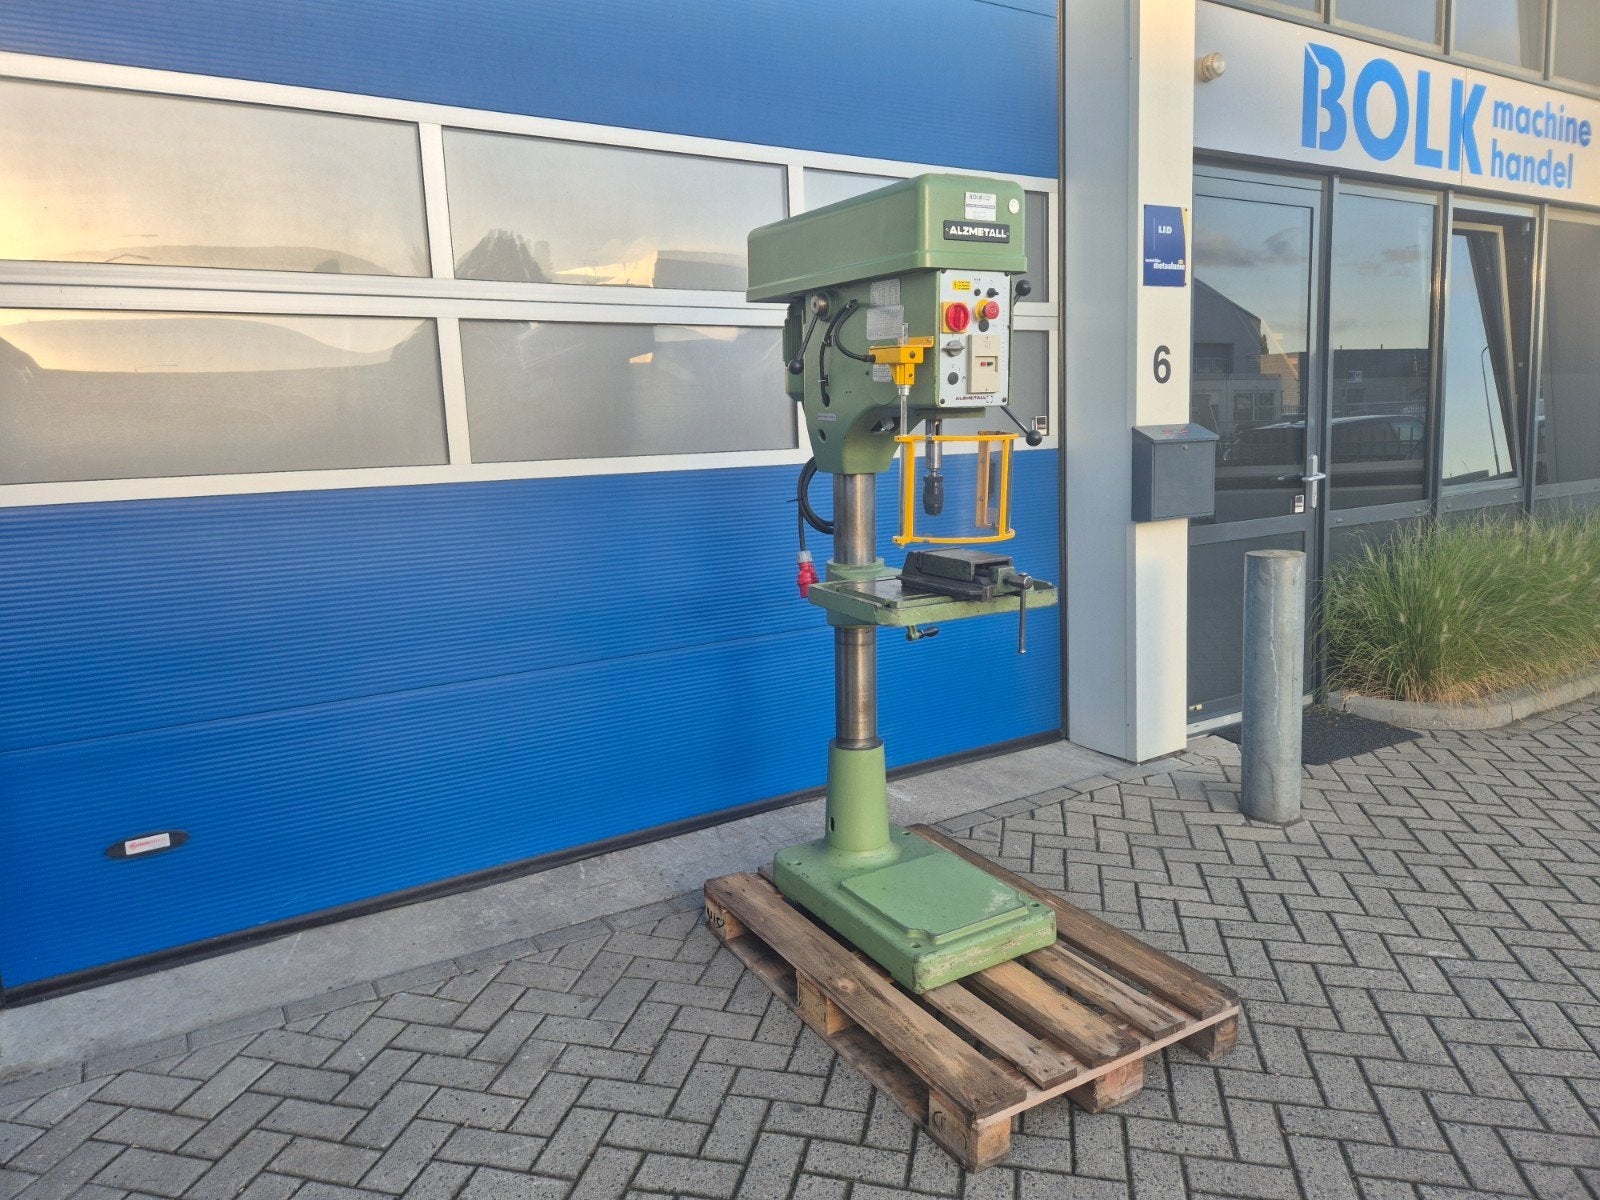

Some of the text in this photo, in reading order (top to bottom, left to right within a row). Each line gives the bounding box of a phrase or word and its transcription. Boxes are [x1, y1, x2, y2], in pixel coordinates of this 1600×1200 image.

[1301, 42, 1487, 175] BOLK
[1492, 99, 1592, 148] machine
[1490, 138, 1574, 190] handel
[949, 225, 1007, 239] ALZMETALL
[1158, 225, 1173, 235] LID
[1153, 344, 1172, 384] 6
